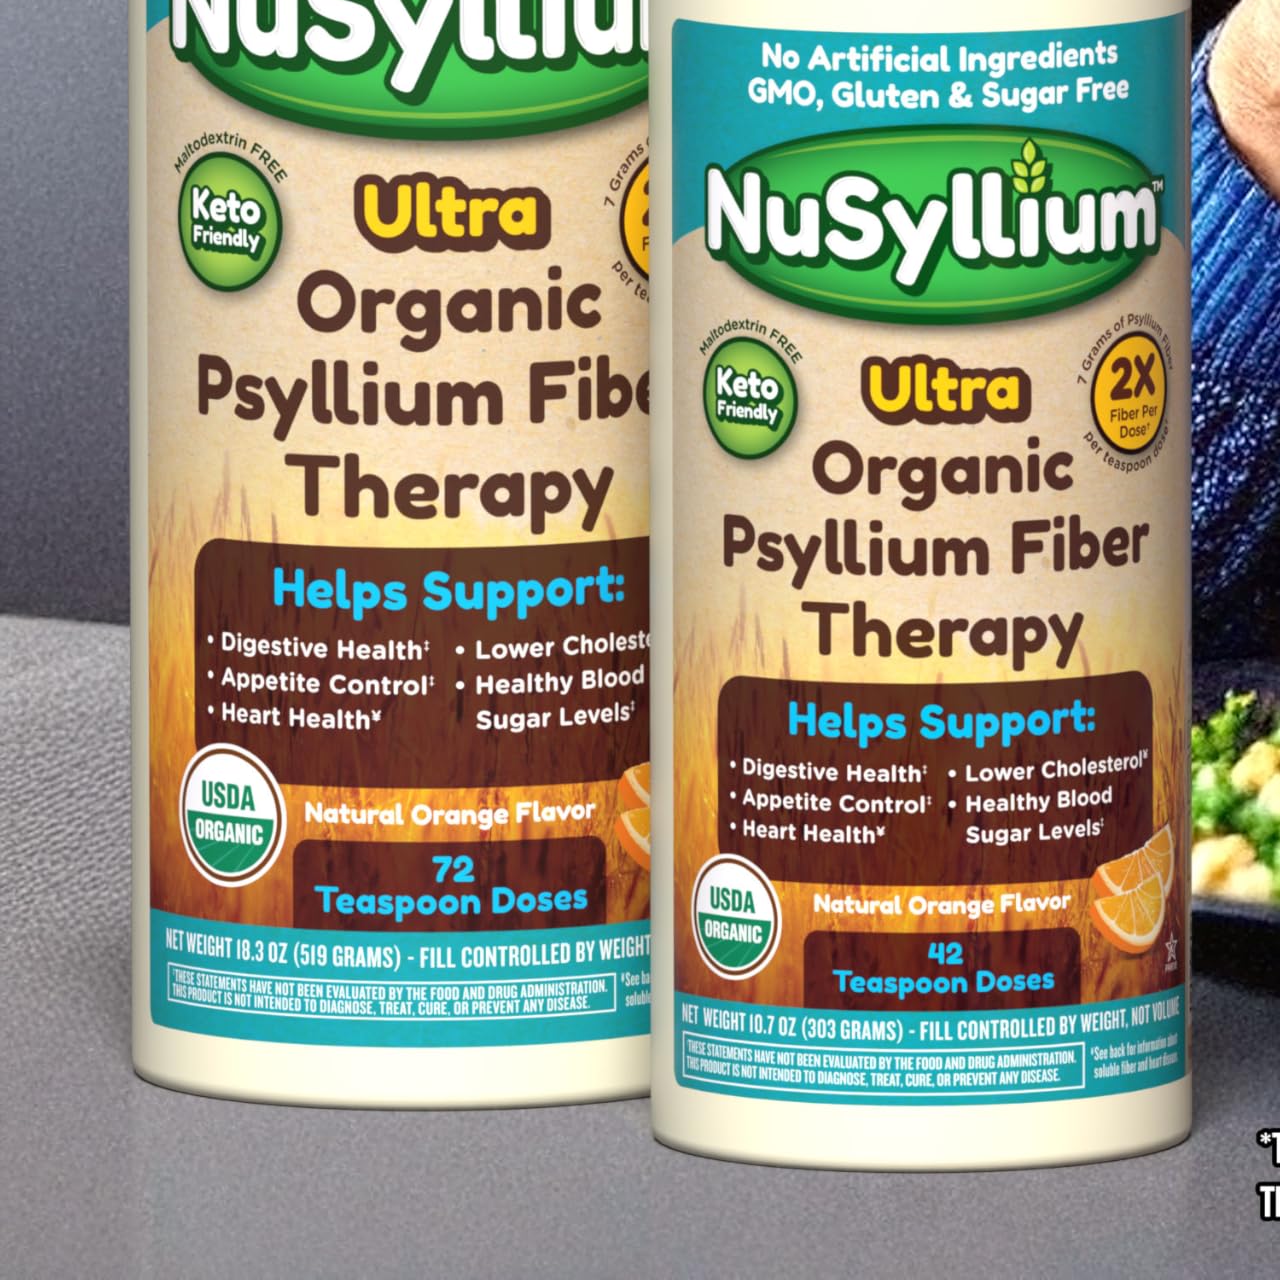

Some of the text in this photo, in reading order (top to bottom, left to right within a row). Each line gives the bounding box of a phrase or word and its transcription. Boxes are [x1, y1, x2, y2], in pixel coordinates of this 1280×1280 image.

[762, 40, 1118, 77] No Artificial Ingredients
[748, 76, 1129, 114] GMO, Gluten & Sugar Free
[174, 131, 288, 184] Maltodextrin FREE
[609, 142, 645, 192] Grams
[192, 187, 261, 227] Keto
[361, 179, 541, 241] Ultra
[193, 222, 260, 253] Friendly
[297, 265, 601, 353] Organic
[699, 318, 803, 365] Maltodextrin FREE
[1081, 312, 1163, 372] Grams of Psyllium
[717, 367, 779, 402] Keto
[866, 361, 1023, 417] Ultra
[1109, 352, 1156, 401] 2X
[198, 353, 503, 442] Psyllium
[717, 397, 778, 425] Friendly
[1110, 404, 1158, 422] Fiber Per
[1083, 431, 1152, 474] per teaspoon
[812, 436, 1074, 512] Organic
[284, 453, 614, 535] Therapy
[723, 514, 1150, 590] Psyllium Fiber
[274, 566, 624, 621] Helps Support:
[221, 631, 328, 659] Digestive
[476, 630, 651, 660] Lower Cholest
[801, 601, 1084, 671] Therapy
[221, 667, 321, 694] Appetite
[476, 664, 644, 695] Healthy Blood
[222, 701, 281, 726] Heart
[476, 710, 552, 733] Sugar
[789, 699, 1095, 749] Helps Support:
[743, 757, 839, 782] Digestive
[966, 764, 1035, 782] Lower
[202, 779, 256, 813] USDA
[742, 788, 832, 812] Appetite
[966, 785, 1113, 813] Healthy Blood
[195, 816, 264, 847] ORGANIC
[304, 800, 596, 831] Natural Orange Flavor
[743, 819, 797, 841] Heart
[966, 826, 1032, 846] Sugar
[432, 855, 475, 883] 72
[314, 885, 588, 923] Teaspoon Doses
[709, 885, 756, 914] USDA
[813, 892, 1072, 920] Natural Orange Flavor
[704, 919, 763, 945] ORGANIC
[166, 927, 184, 950] NET
[186, 932, 233, 958] WEIGHT
[236, 939, 264, 962] 18.3
[268, 941, 288, 964] OZ
[293, 942, 328, 968] (519
[332, 945, 401, 972] GRAMS)
[419, 946, 456, 969] FILL
[461, 942, 571, 968] CONTROLLED
[575, 940, 595, 963] BY
[927, 942, 963, 965] 42
[196, 972, 609, 1001] STATEMENTS HAVE NOT BEEN EVALUATED BY THE FOOD AND DRUG ADMINISTRATION.
[832, 969, 1055, 1000] Teaspoon Doses
[682, 1003, 1150, 1043] NET WEIGHT 10.7 OZ (303 GRAMS) FILL CONTROLLED BY WEIGHT, NOT
